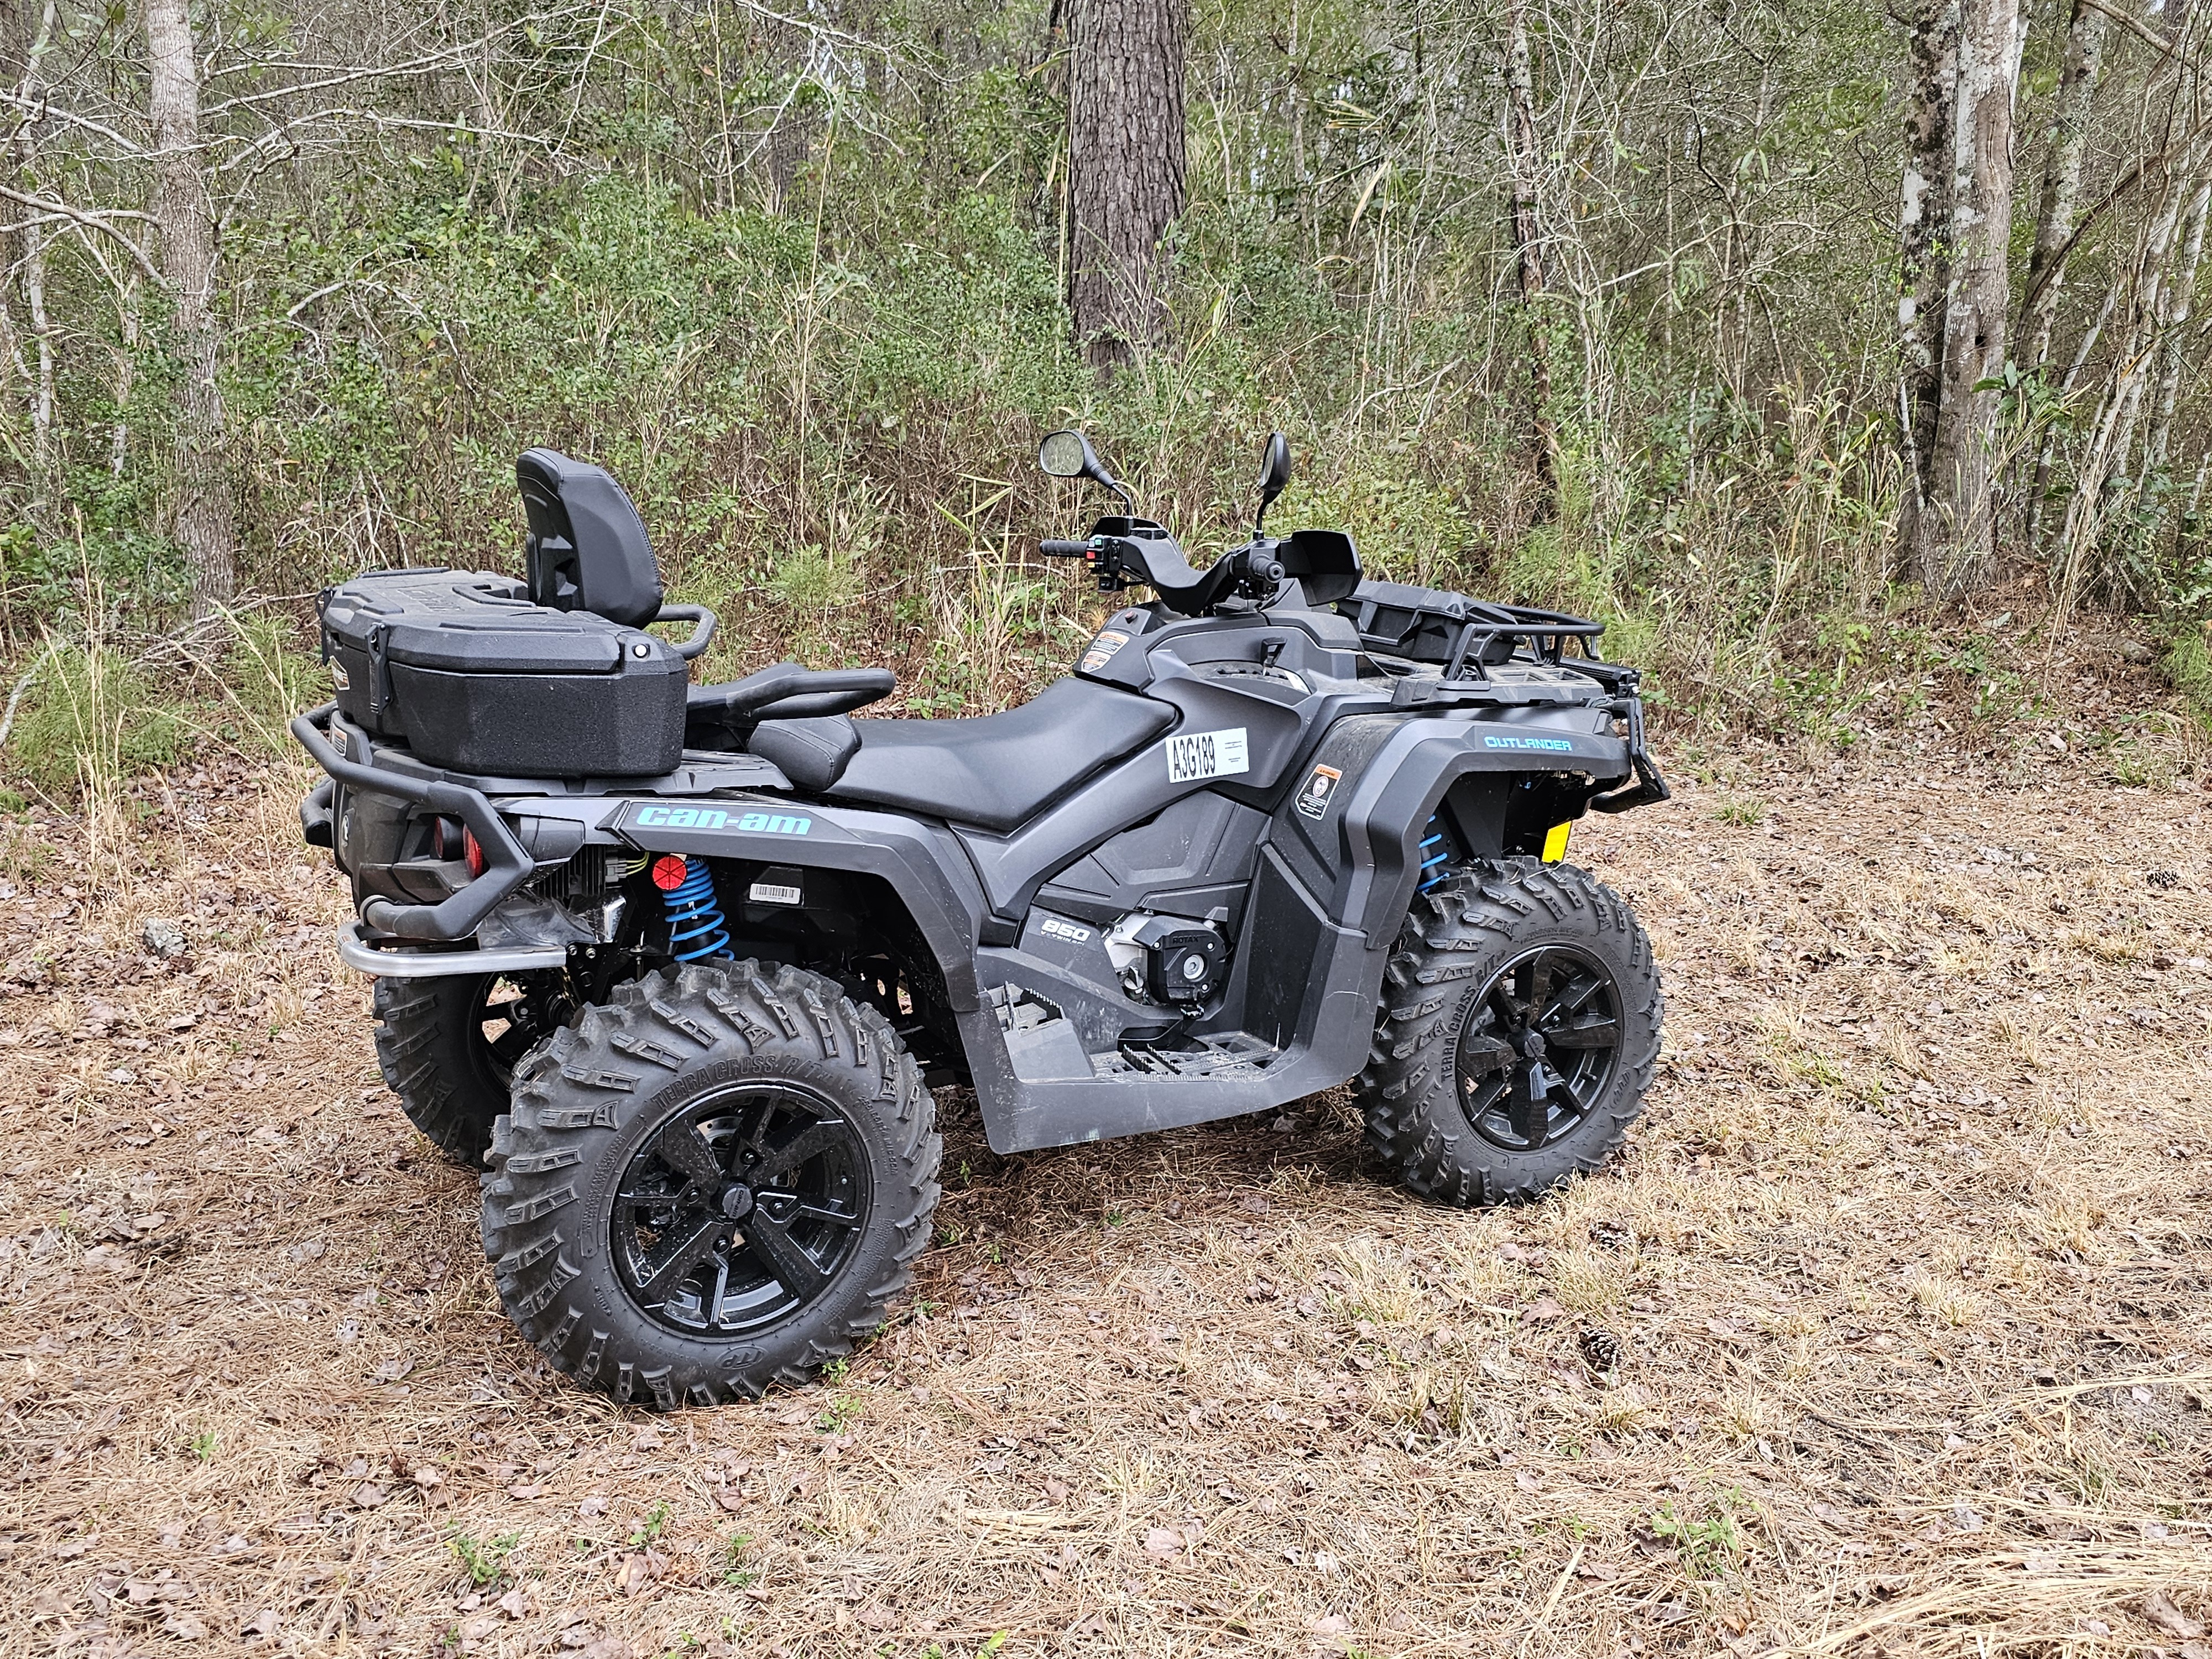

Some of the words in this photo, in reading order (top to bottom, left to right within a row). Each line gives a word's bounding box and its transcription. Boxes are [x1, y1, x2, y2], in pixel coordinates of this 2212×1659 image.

[1173, 735, 1215, 780] A3G189
[1484, 737, 1573, 751] OUTLANDER
[637, 807, 812, 835] can-am
[1041, 920, 1091, 941] 850
[1173, 935, 1198, 944] ROTAX
[1441, 1036, 1457, 1083] TERRA
[1449, 985, 1477, 1032] CROSS
[650, 1067, 712, 1109] TERRA
[714, 1054, 776, 1079] CROSS
